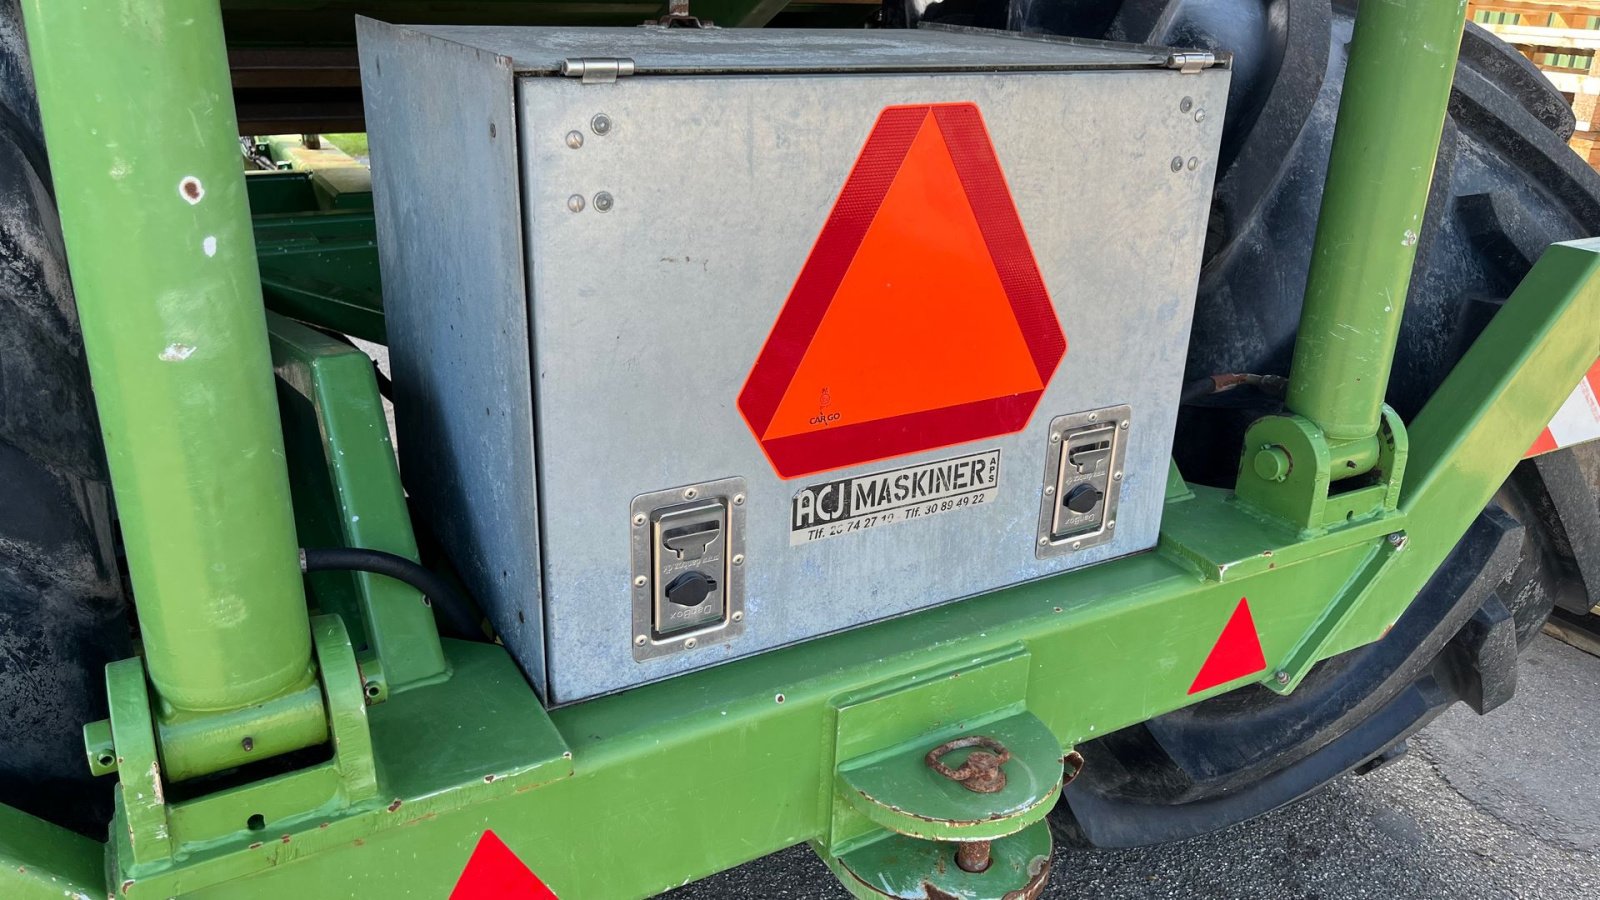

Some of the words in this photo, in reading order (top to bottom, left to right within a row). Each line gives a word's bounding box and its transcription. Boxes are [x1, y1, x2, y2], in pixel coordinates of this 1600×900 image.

[809, 412, 841, 425] CARGO
[854, 459, 986, 511] MASKINER
[987, 457, 997, 483] APS
[808, 528, 825, 540] Tlf.
[847, 519, 860, 532] 74
[864, 517, 877, 529] 27
[905, 506, 921, 519] Tlf.
[924, 503, 938, 515] 30
[940, 500, 954, 512] 89
[956, 496, 969, 508] 49
[971, 493, 985, 505] 22
